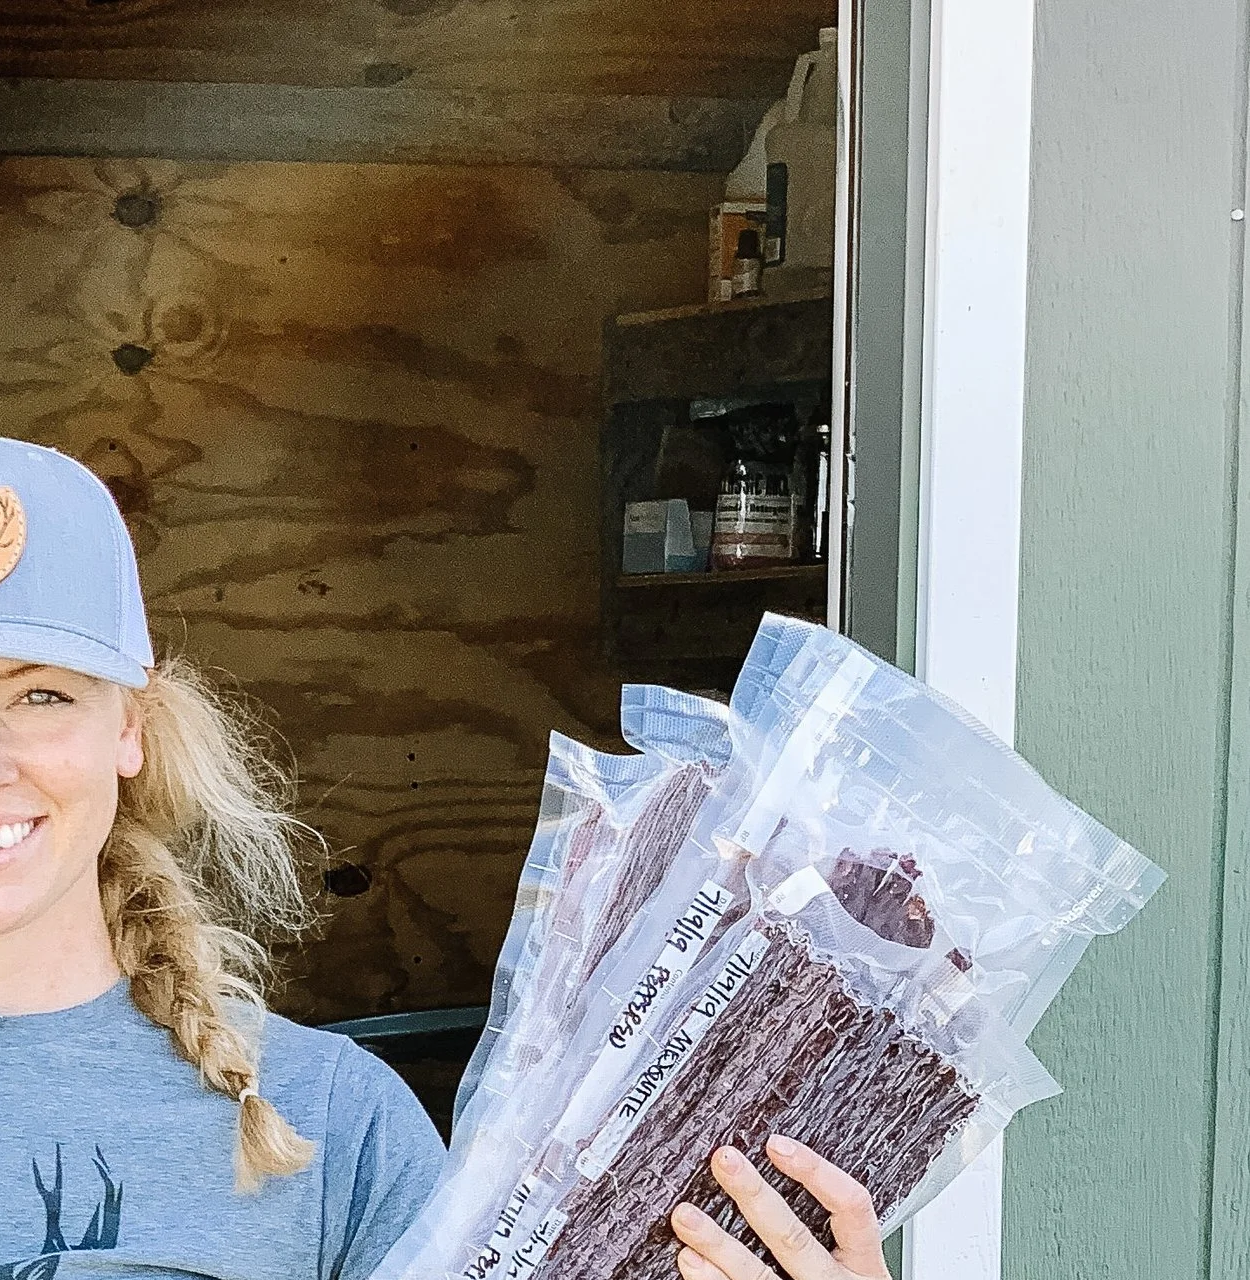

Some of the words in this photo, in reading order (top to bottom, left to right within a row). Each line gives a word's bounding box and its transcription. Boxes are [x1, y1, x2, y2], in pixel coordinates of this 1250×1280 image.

[666, 890, 723, 953] 7/19/19
[609, 964, 671, 1049] PEPPERED
[691, 951, 755, 1018] 7/19/19
